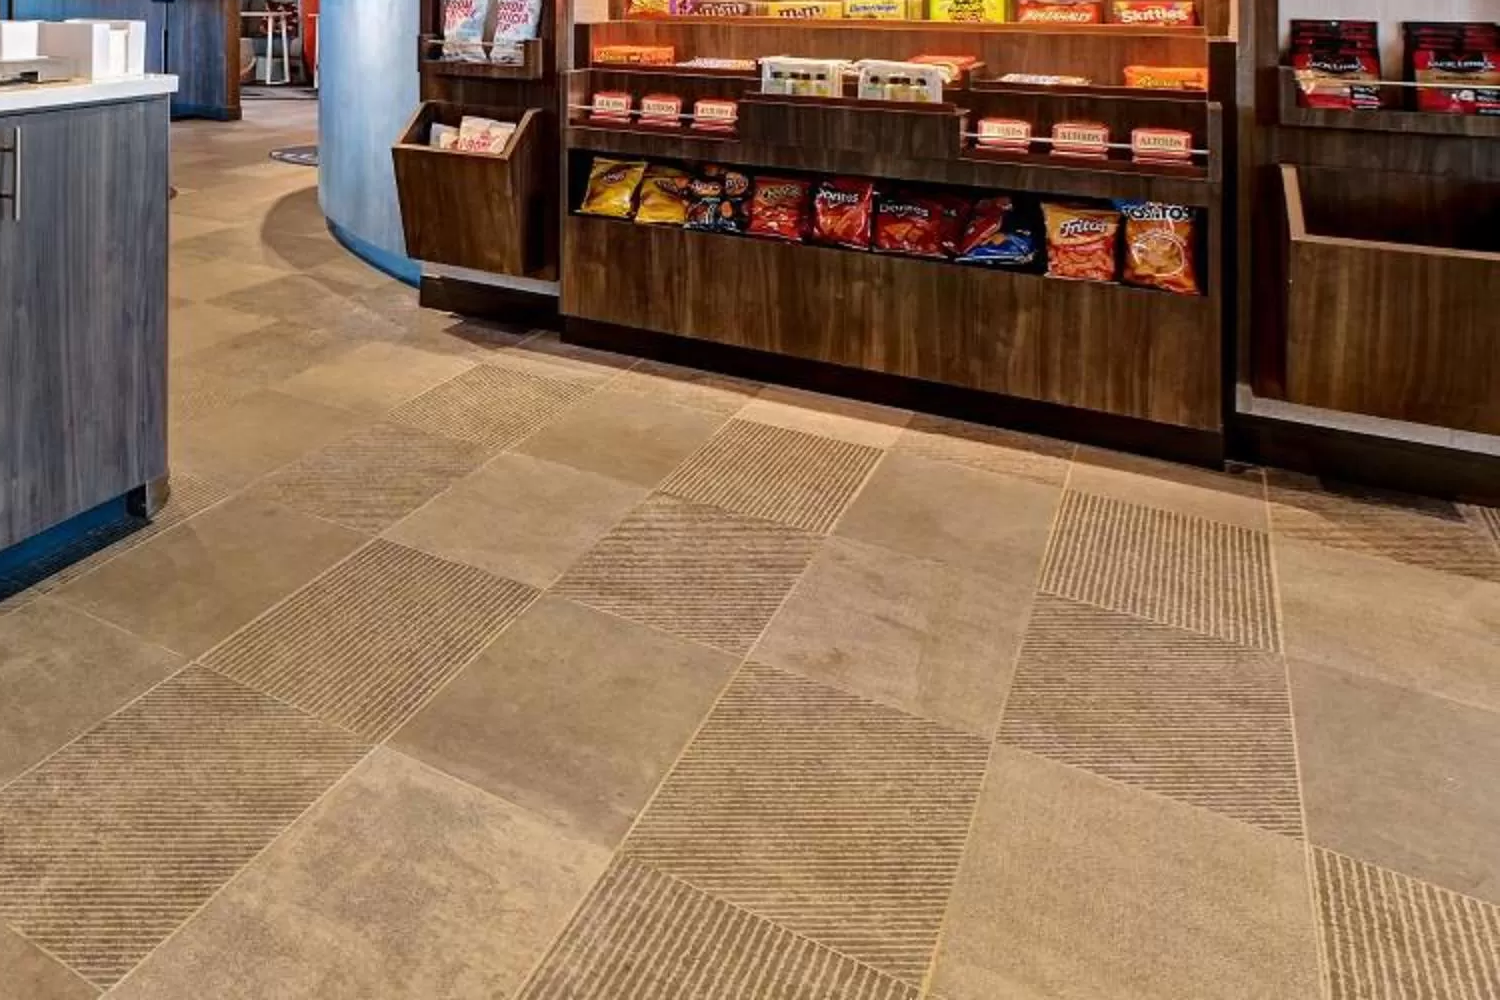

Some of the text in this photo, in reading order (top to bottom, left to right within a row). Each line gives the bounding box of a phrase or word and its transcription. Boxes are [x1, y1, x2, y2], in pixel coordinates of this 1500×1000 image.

[1121, 6, 1189, 24] Skittles
[1139, 136, 1182, 148] ALTOIDS
[879, 203, 929, 217] Doritos
[1059, 219, 1108, 236] Fritos
